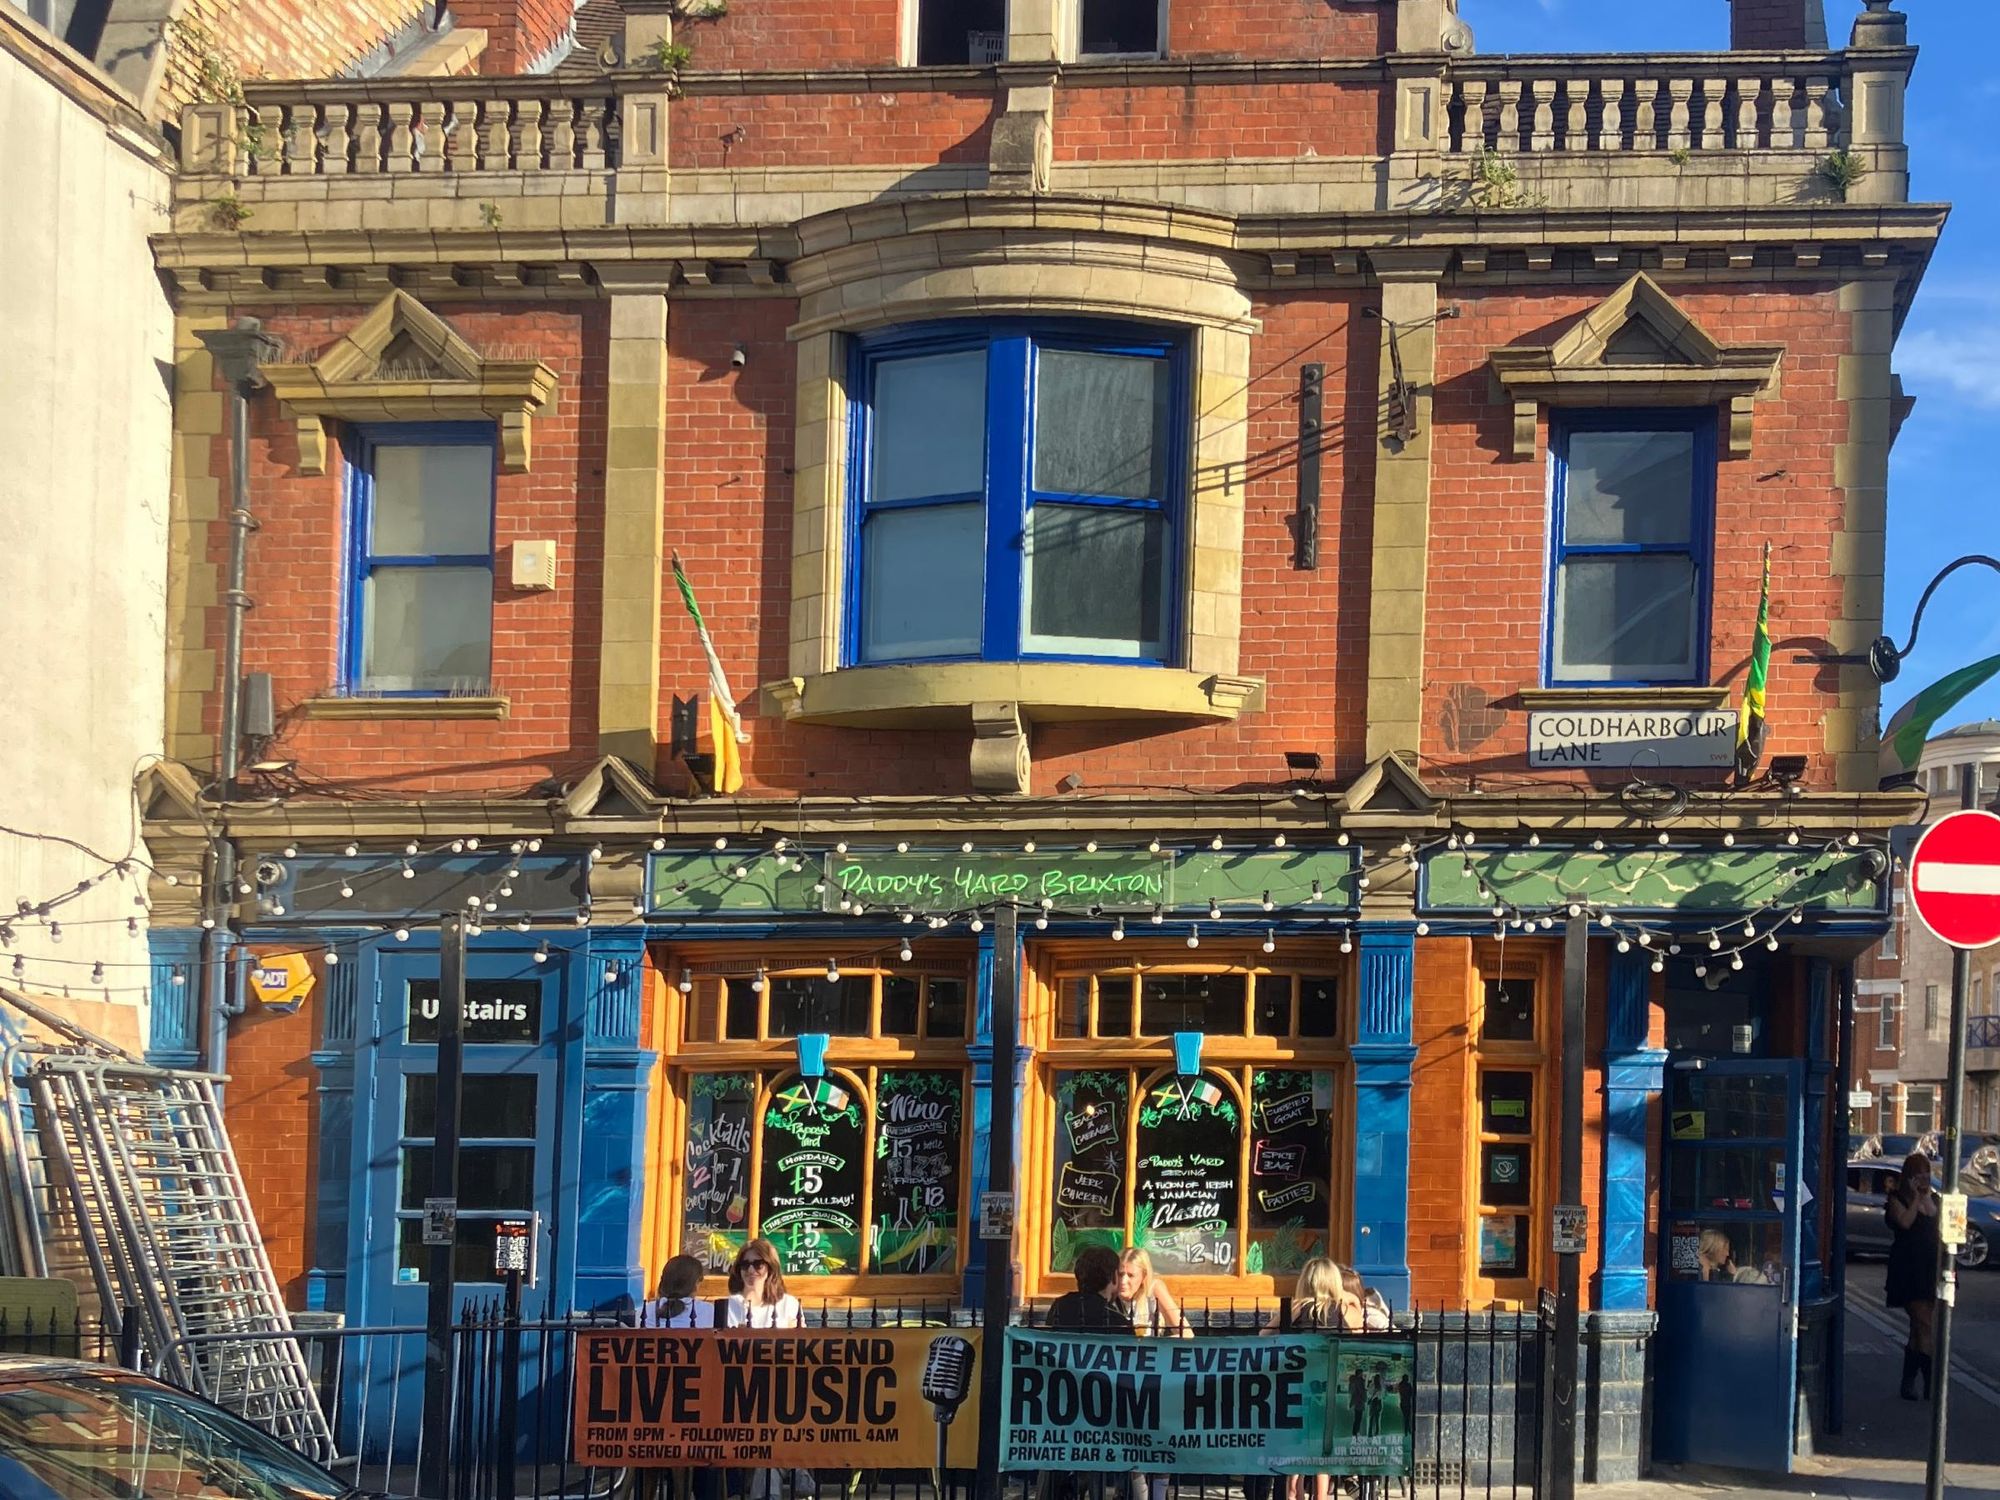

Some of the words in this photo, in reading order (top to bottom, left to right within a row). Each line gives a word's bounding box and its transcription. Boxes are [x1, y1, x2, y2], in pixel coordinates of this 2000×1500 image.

[1538, 717, 1728, 737] COLDHARBOUR
[1538, 742, 1602, 762] LANE
[955, 867, 1028, 898] YARD
[1040, 870, 1163, 896] BRIXTON
[262, 971, 288, 986] ADT
[421, 998, 528, 1021] Ustairs
[881, 1094, 952, 1122] Wine
[1266, 1096, 1310, 1116] CURRIED
[1274, 1107, 1305, 1125] GOAT
[686, 1112, 750, 1172] Cocktails
[1075, 1123, 1112, 1145] CABBAGE
[785, 1153, 837, 1166] MONDAYS
[1262, 1151, 1296, 1160] SPICE
[693, 1166, 711, 1188] 2
[711, 1152, 728, 1187] for
[729, 1157, 742, 1181] 1
[1161, 1168, 1207, 1177] SERVING
[1263, 1161, 1293, 1171] BAG
[790, 1165, 823, 1195] £5
[893, 1176, 938, 1185] FRIDAYS
[1075, 1174, 1104, 1189] JERK
[1205, 1180, 1233, 1189] IRISH
[686, 1186, 733, 1214] everyday!
[771, 1197, 805, 1207] PINTS
[1061, 1187, 1108, 1205] CHICKEN
[1266, 1186, 1310, 1207] PATTIES
[1152, 1201, 1220, 1229] Classics
[687, 1222, 719, 1234] DEALS
[788, 1222, 820, 1250] £5
[786, 1250, 827, 1259] PINTS
[589, 1337, 704, 1364] EVERY
[718, 1339, 894, 1365] WEEKEND
[1011, 1339, 1158, 1371] PRIVATE
[1171, 1344, 1308, 1373] EVENTS
[587, 1366, 700, 1423] LIVE
[722, 1366, 897, 1425] MUSIC
[1009, 1367, 1162, 1430] ROOM
[1183, 1372, 1304, 1430] HIRE
[587, 1428, 627, 1441] FROM
[633, 1428, 665, 1442] 9PM
[681, 1428, 754, 1442] FOLLOWED
[760, 1428, 778, 1442] BY
[783, 1428, 815, 1442] DJ'S
[820, 1429, 861, 1442] UNTIL
[865, 1428, 899, 1442] 4AM
[1009, 1430, 1039, 1444] FOR
[1042, 1431, 1069, 1444] ALL
[1073, 1432, 1152, 1447] OCCASIONS
[1168, 1434, 1201, 1448] 4AM
[1206, 1433, 1265, 1448] LICENCE
[1351, 1435, 1369, 1446] ASK
[1371, 1435, 1383, 1445] AT
[1385, 1434, 1403, 1445] BAR
[587, 1445, 623, 1459] FOOD
[628, 1445, 681, 1459] SERVED
[687, 1445, 727, 1459] UNTIL
[732, 1446, 772, 1459] 10PM
[1008, 1447, 1066, 1462] PRIVATE
[1071, 1448, 1100, 1462] BAR
[1105, 1449, 1117, 1463] &
[1122, 1449, 1176, 1464] TOILETS
[1350, 1446, 1388, 1456] CONTACT
[1391, 1446, 1403, 1455] US
